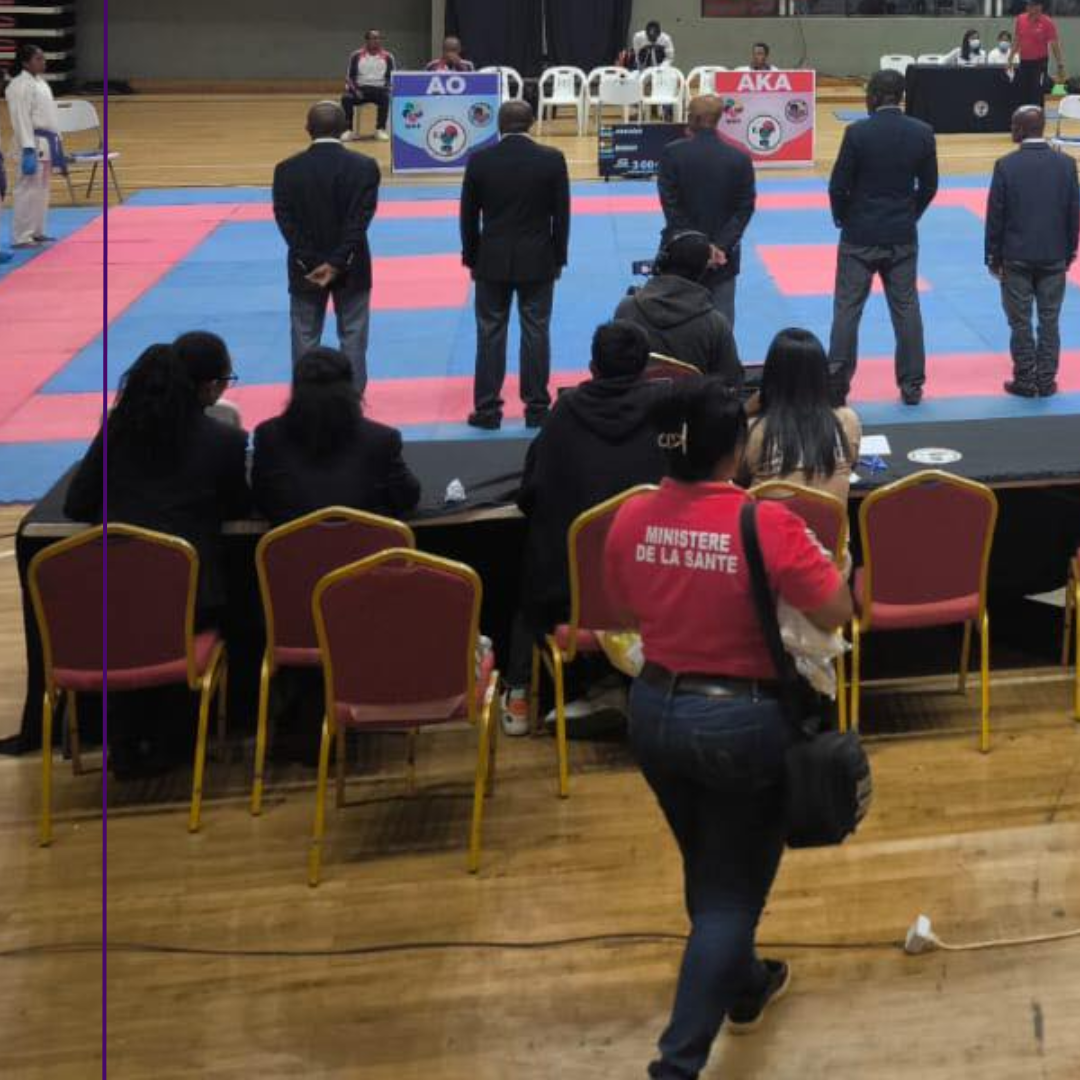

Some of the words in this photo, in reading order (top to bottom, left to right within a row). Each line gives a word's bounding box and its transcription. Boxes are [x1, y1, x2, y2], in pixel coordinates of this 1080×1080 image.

[426, 76, 467, 94] AO
[737, 74, 792, 91] AKA
[645, 526, 731, 552] MINISTERE
[636, 544, 657, 563] DE
[660, 550, 680, 566] LA
[684, 551, 738, 574] SANTE
